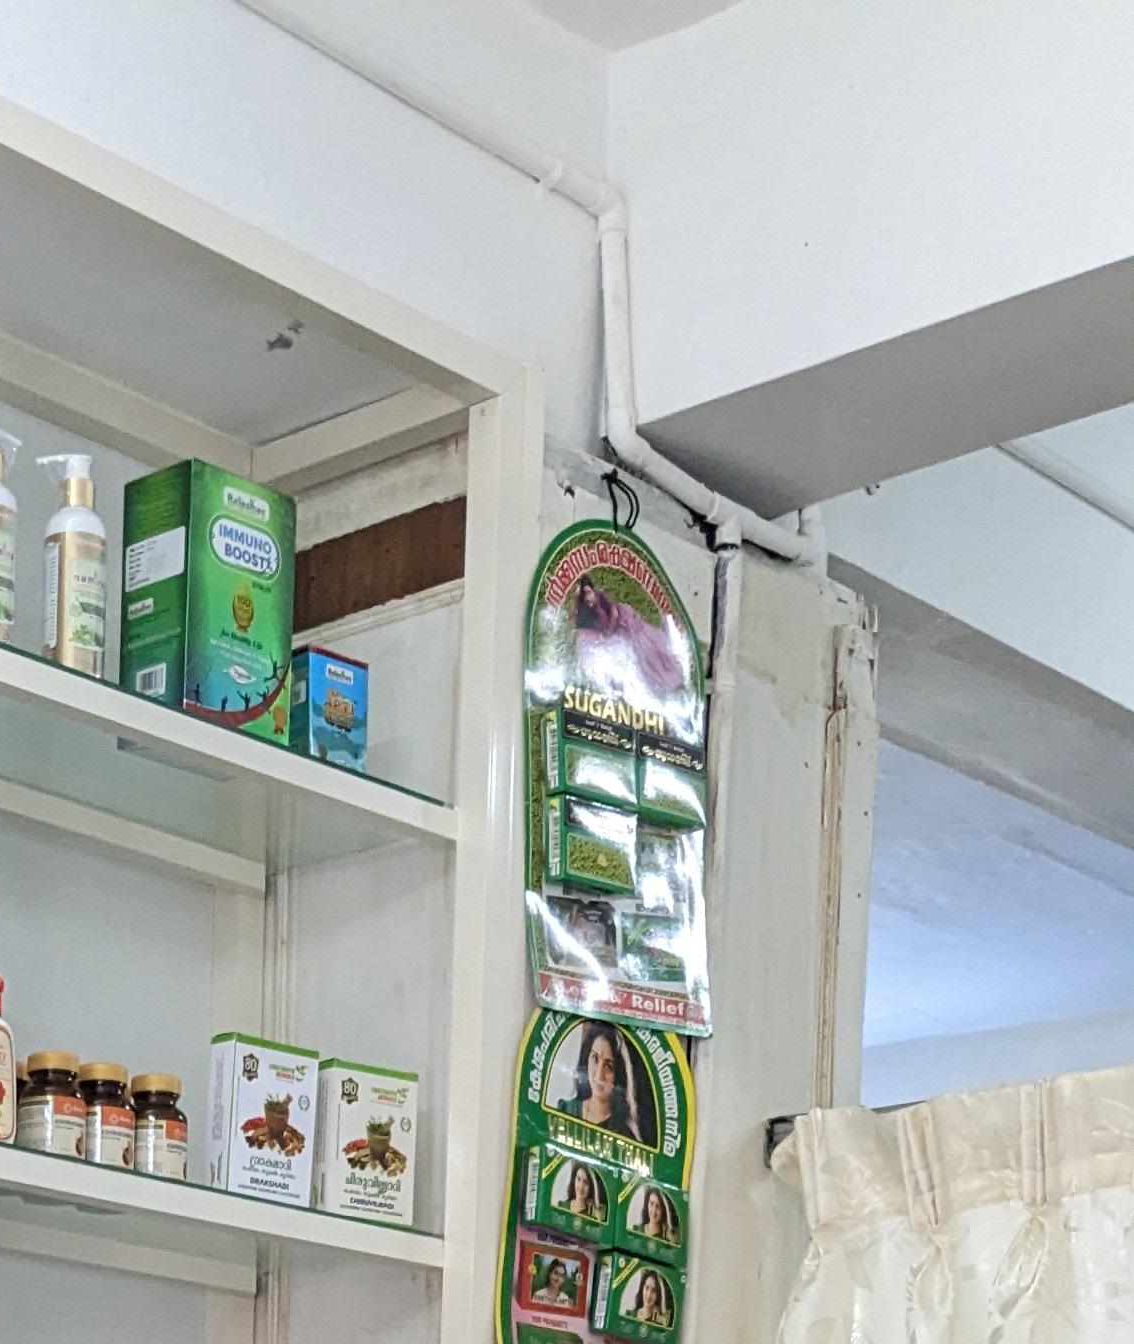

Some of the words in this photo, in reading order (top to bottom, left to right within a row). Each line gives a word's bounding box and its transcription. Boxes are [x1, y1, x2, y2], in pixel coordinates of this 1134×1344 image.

[219, 522, 272, 556] IMMUNO
[563, 683, 666, 736] SUGANDHI
[632, 993, 686, 1016] Relief
[244, 1057, 258, 1073] 80
[343, 1080, 357, 1096] 80
[250, 1176, 290, 1191] DRAKSHADI
